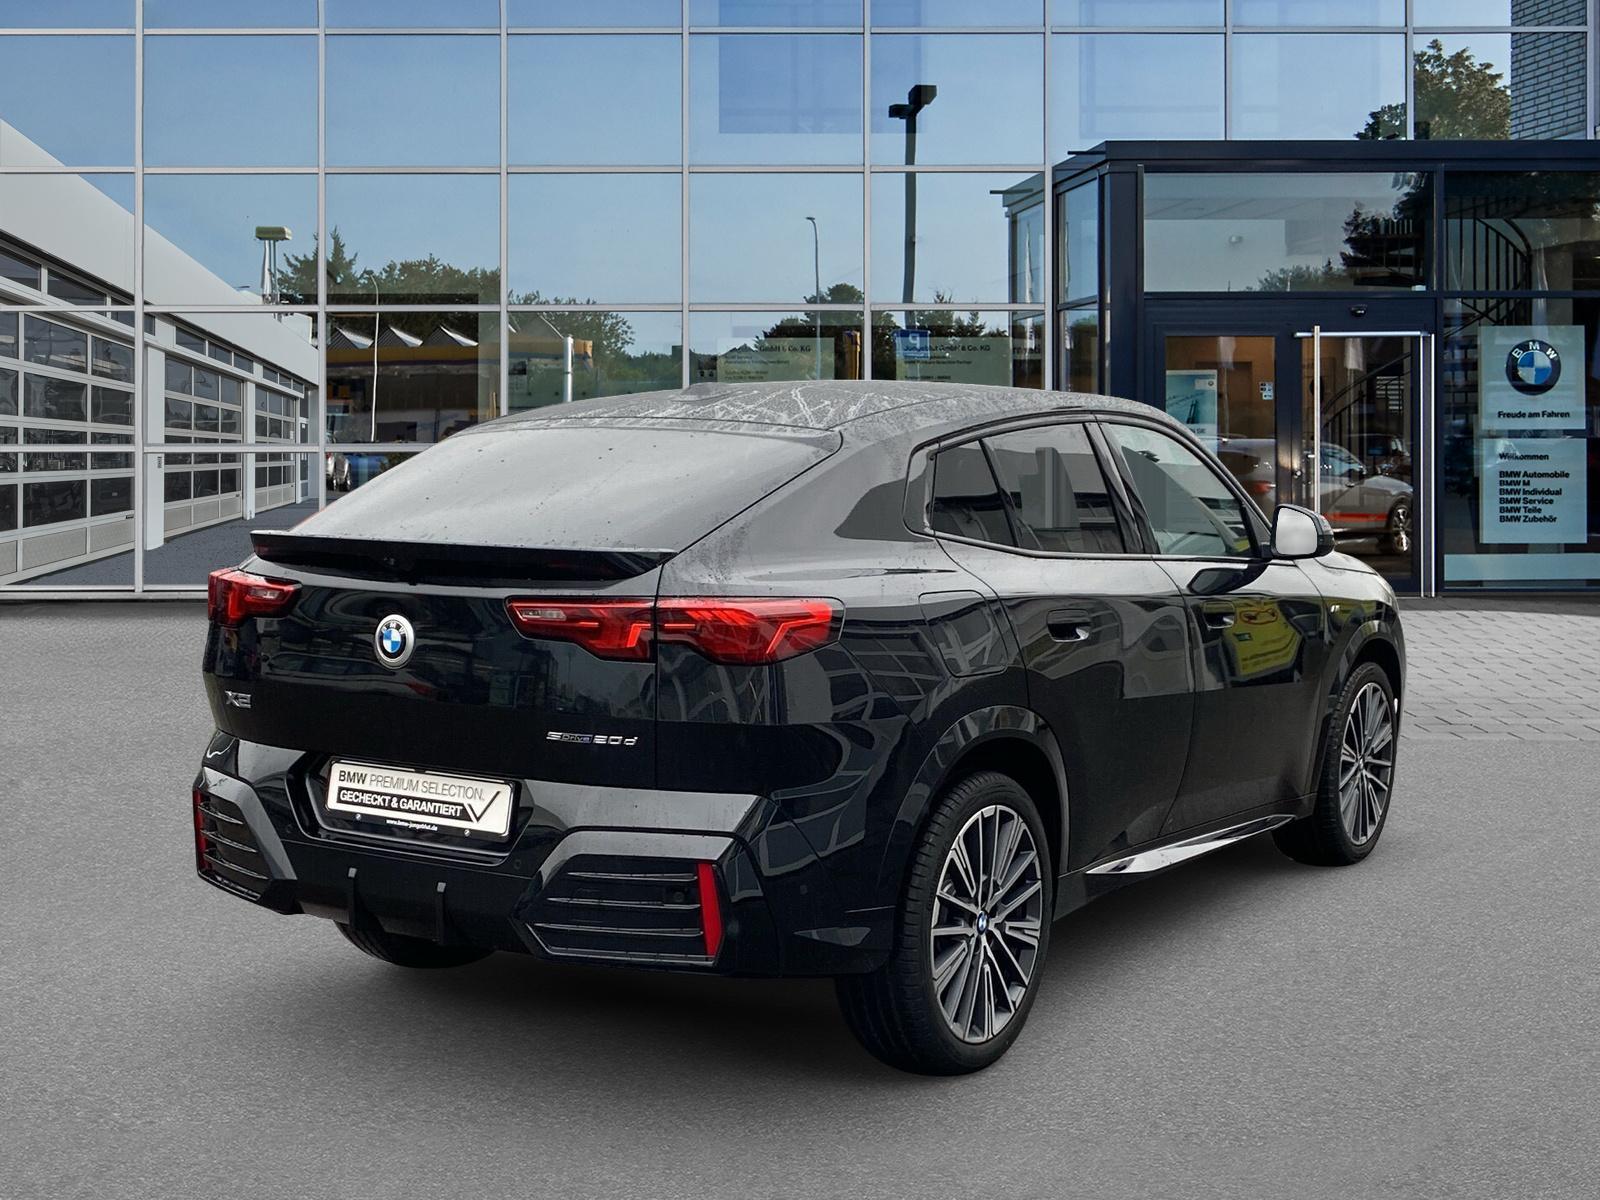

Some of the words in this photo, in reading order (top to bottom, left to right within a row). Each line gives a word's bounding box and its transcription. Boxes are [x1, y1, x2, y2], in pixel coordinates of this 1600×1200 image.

[800, 344, 811, 352] KG
[980, 344, 991, 352] KG
[1511, 341, 1558, 360] BMW
[1497, 410, 1526, 419] Freude
[1541, 410, 1570, 419] Fahren
[1499, 452, 1549, 461] Willkommen
[1499, 471, 1521, 479] BMW
[1522, 471, 1569, 479] Automobile
[1499, 488, 1521, 496] BMW
[1522, 488, 1562, 496] Individual
[1499, 496, 1521, 505] BMW
[1522, 496, 1554, 505] Service
[1499, 506, 1521, 514] BMW
[1522, 506, 1542, 514] Teile
[1499, 515, 1521, 523] BMW
[1522, 515, 1557, 523] Zubehör
[225, 690, 251, 709] X2
[338, 770, 367, 784] BMW
[369, 773, 419, 792] PREMIUM
[339, 789, 391, 807] GECHECKT
[390, 796, 398, 808] &
[399, 798, 463, 817] GARANTIERT
